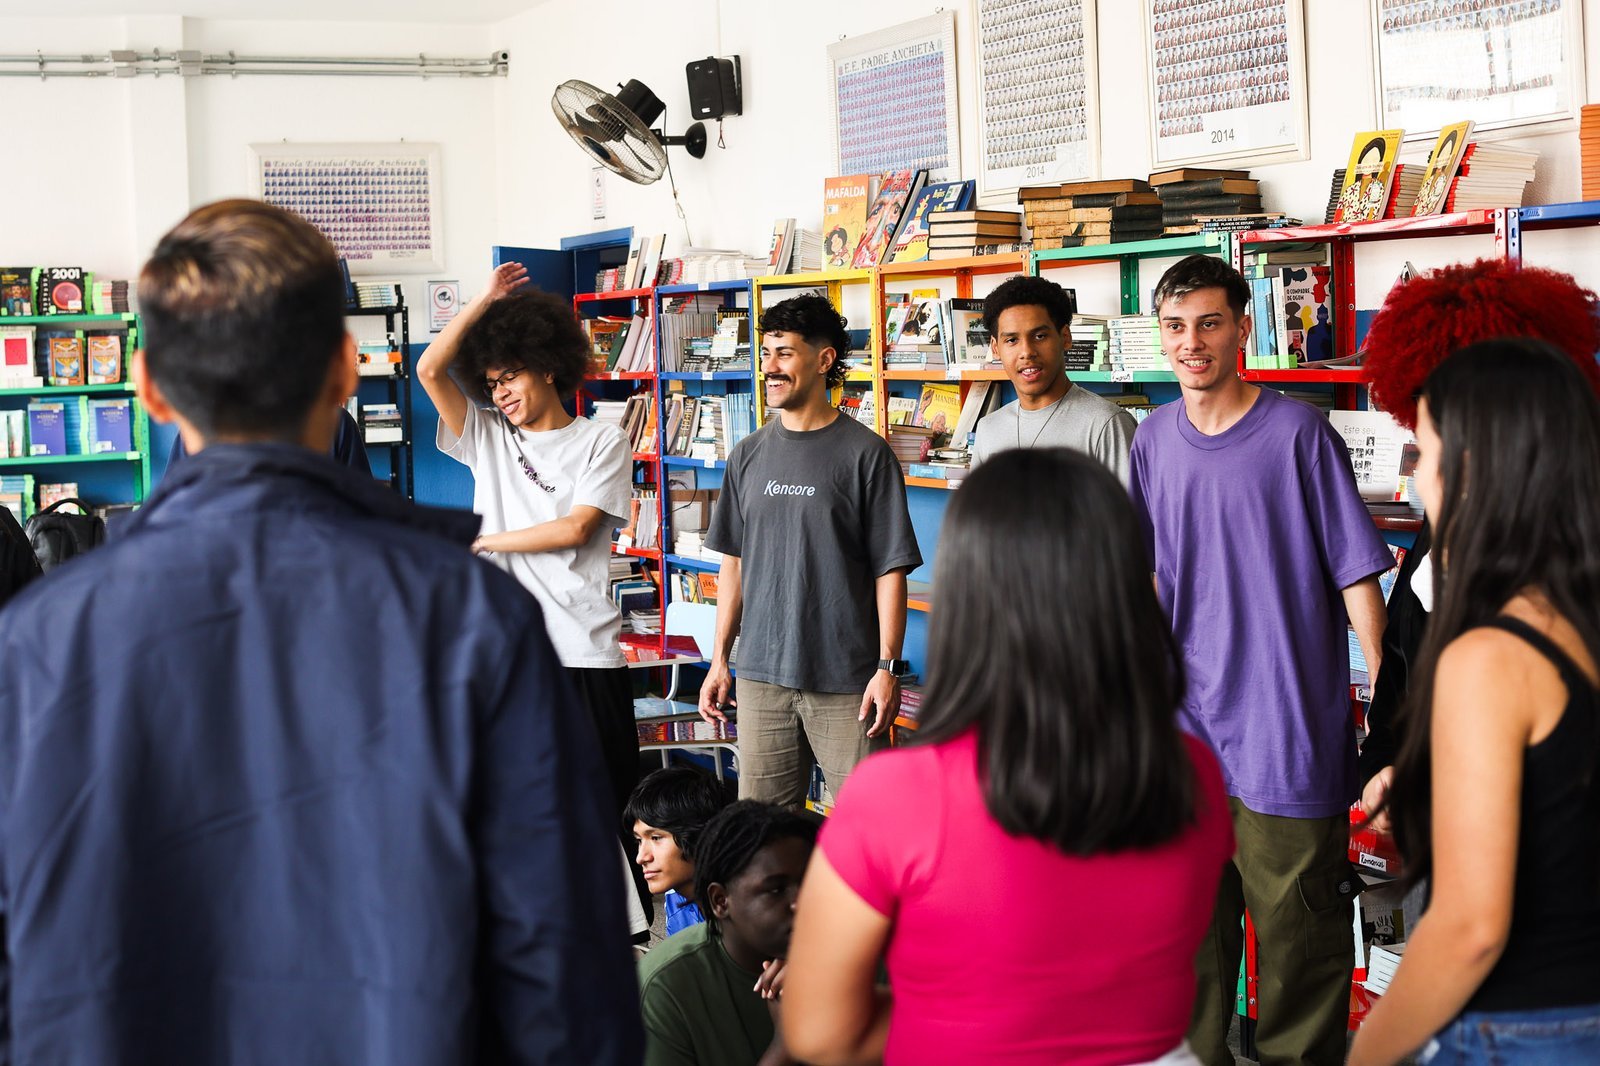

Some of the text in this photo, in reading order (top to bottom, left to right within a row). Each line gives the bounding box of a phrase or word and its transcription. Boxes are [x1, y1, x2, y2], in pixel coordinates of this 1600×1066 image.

[844, 40, 935, 73] E.E. PADRE ANCHIETA
[1211, 128, 1235, 143] 2014
[1026, 165, 1045, 178] 2014
[826, 185, 866, 199] MAFALDA
[51, 268, 81, 280] 2001
[1344, 425, 1360, 434] Este
[763, 480, 816, 497] Kencore
